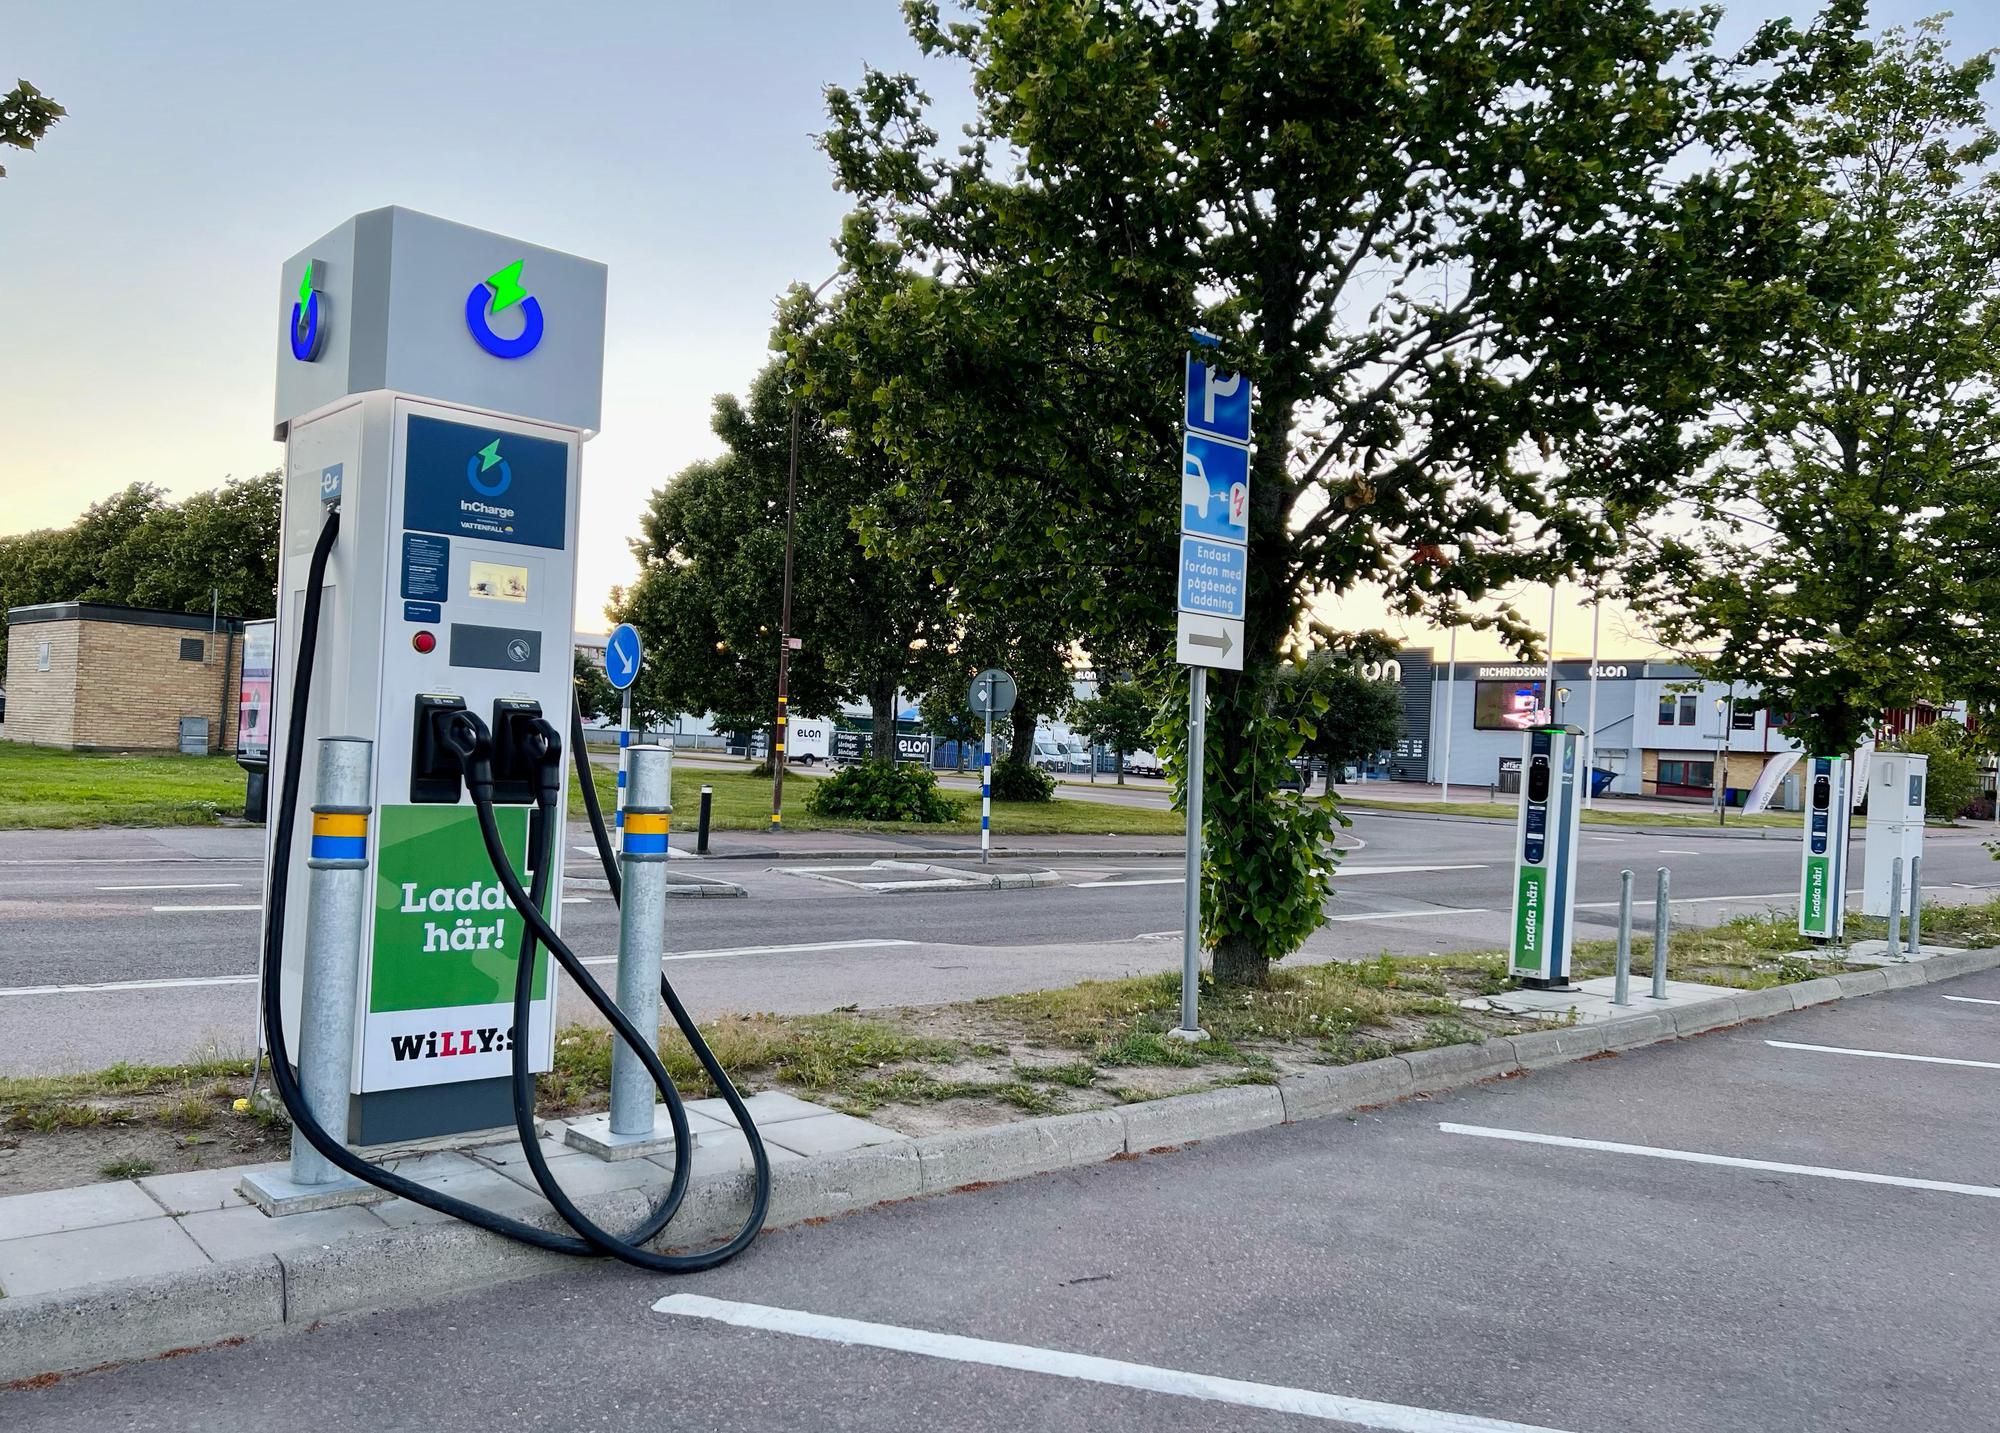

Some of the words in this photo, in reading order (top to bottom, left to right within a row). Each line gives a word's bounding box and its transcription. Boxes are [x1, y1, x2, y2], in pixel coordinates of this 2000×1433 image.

[460, 500, 515, 518] InCharge
[460, 521, 504, 533] VATTENFALL
[1197, 545, 1231, 563] Endast
[1185, 559, 1219, 577] fordon
[1221, 568, 1242, 580] med
[1187, 577, 1238, 595] pågående
[1190, 591, 1234, 612] laddning
[1526, 881, 1538, 907] här!
[1811, 888, 1821, 918] Ladda
[423, 918, 505, 952] här!
[1524, 909, 1537, 951] Ladda
